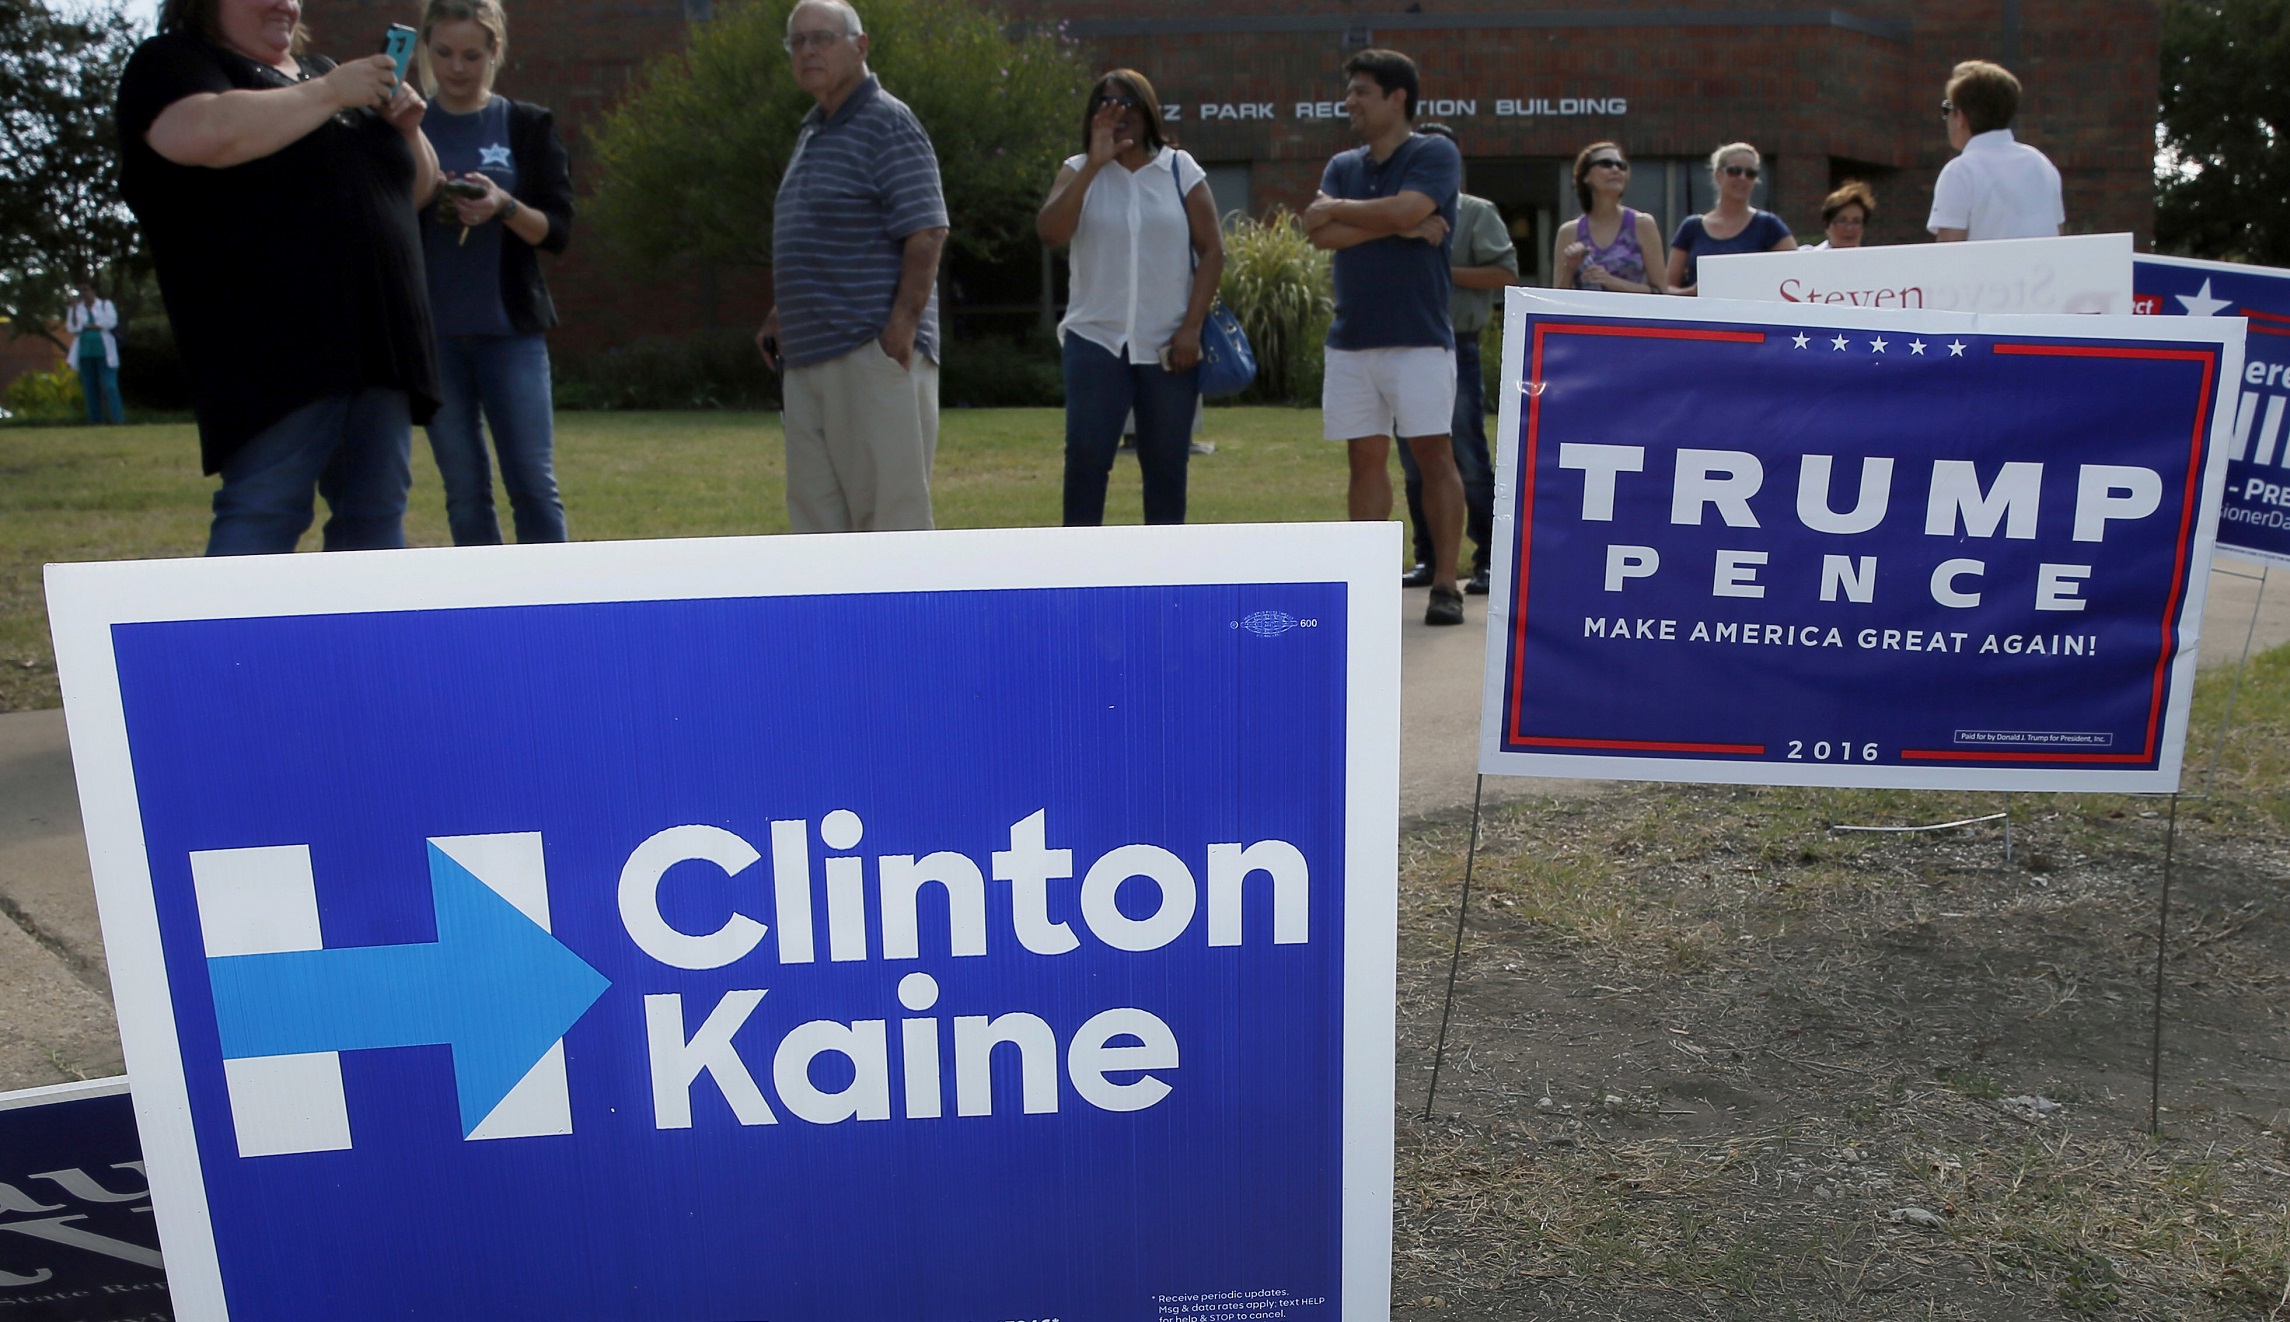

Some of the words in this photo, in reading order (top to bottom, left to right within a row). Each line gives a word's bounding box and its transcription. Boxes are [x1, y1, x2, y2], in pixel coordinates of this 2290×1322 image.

[1157, 104, 1181, 120] Z
[1200, 103, 1275, 120] PARK
[1295, 101, 1476, 118] RECTION
[1495, 98, 1628, 115] BUILDING
[1558, 442, 2163, 543] TRUMP
[1604, 544, 2092, 611] PENCE
[1300, 618, 1318, 628] 600
[1584, 617, 1677, 640] MAKE
[1689, 621, 1843, 648] AMERICA
[1857, 628, 1968, 653] GREAT
[1979, 634, 2097, 656] AGAIN!
[1961, 732, 1975, 740] Paid
[1976, 732, 1986, 740] for
[1987, 733, 1995, 742] by
[1996, 733, 2020, 741] Donald
[2027, 733, 2048, 742] Trump
[1787, 740, 1878, 762] 2016
[617, 807, 1309, 970] Clinton
[643, 971, 1180, 1130] Kaine
[1158, 1293, 1199, 1303] Receive
[1201, 1290, 1242, 1302] periodic
[1244, 1289, 1289, 1299] updates.
[1158, 1305, 1179, 1315] Msg
[1181, 1304, 1189, 1313] &
[1191, 1303, 1216, 1312] data
[1217, 1302, 1244, 1310] rates
[1279, 1299, 1299, 1307] text
[1301, 1297, 1325, 1305] HELP
[1199, 1314, 1207, 1322] &
[1209, 1313, 1234, 1321] STOP
[1249, 1309, 1286, 1319] cancel.
